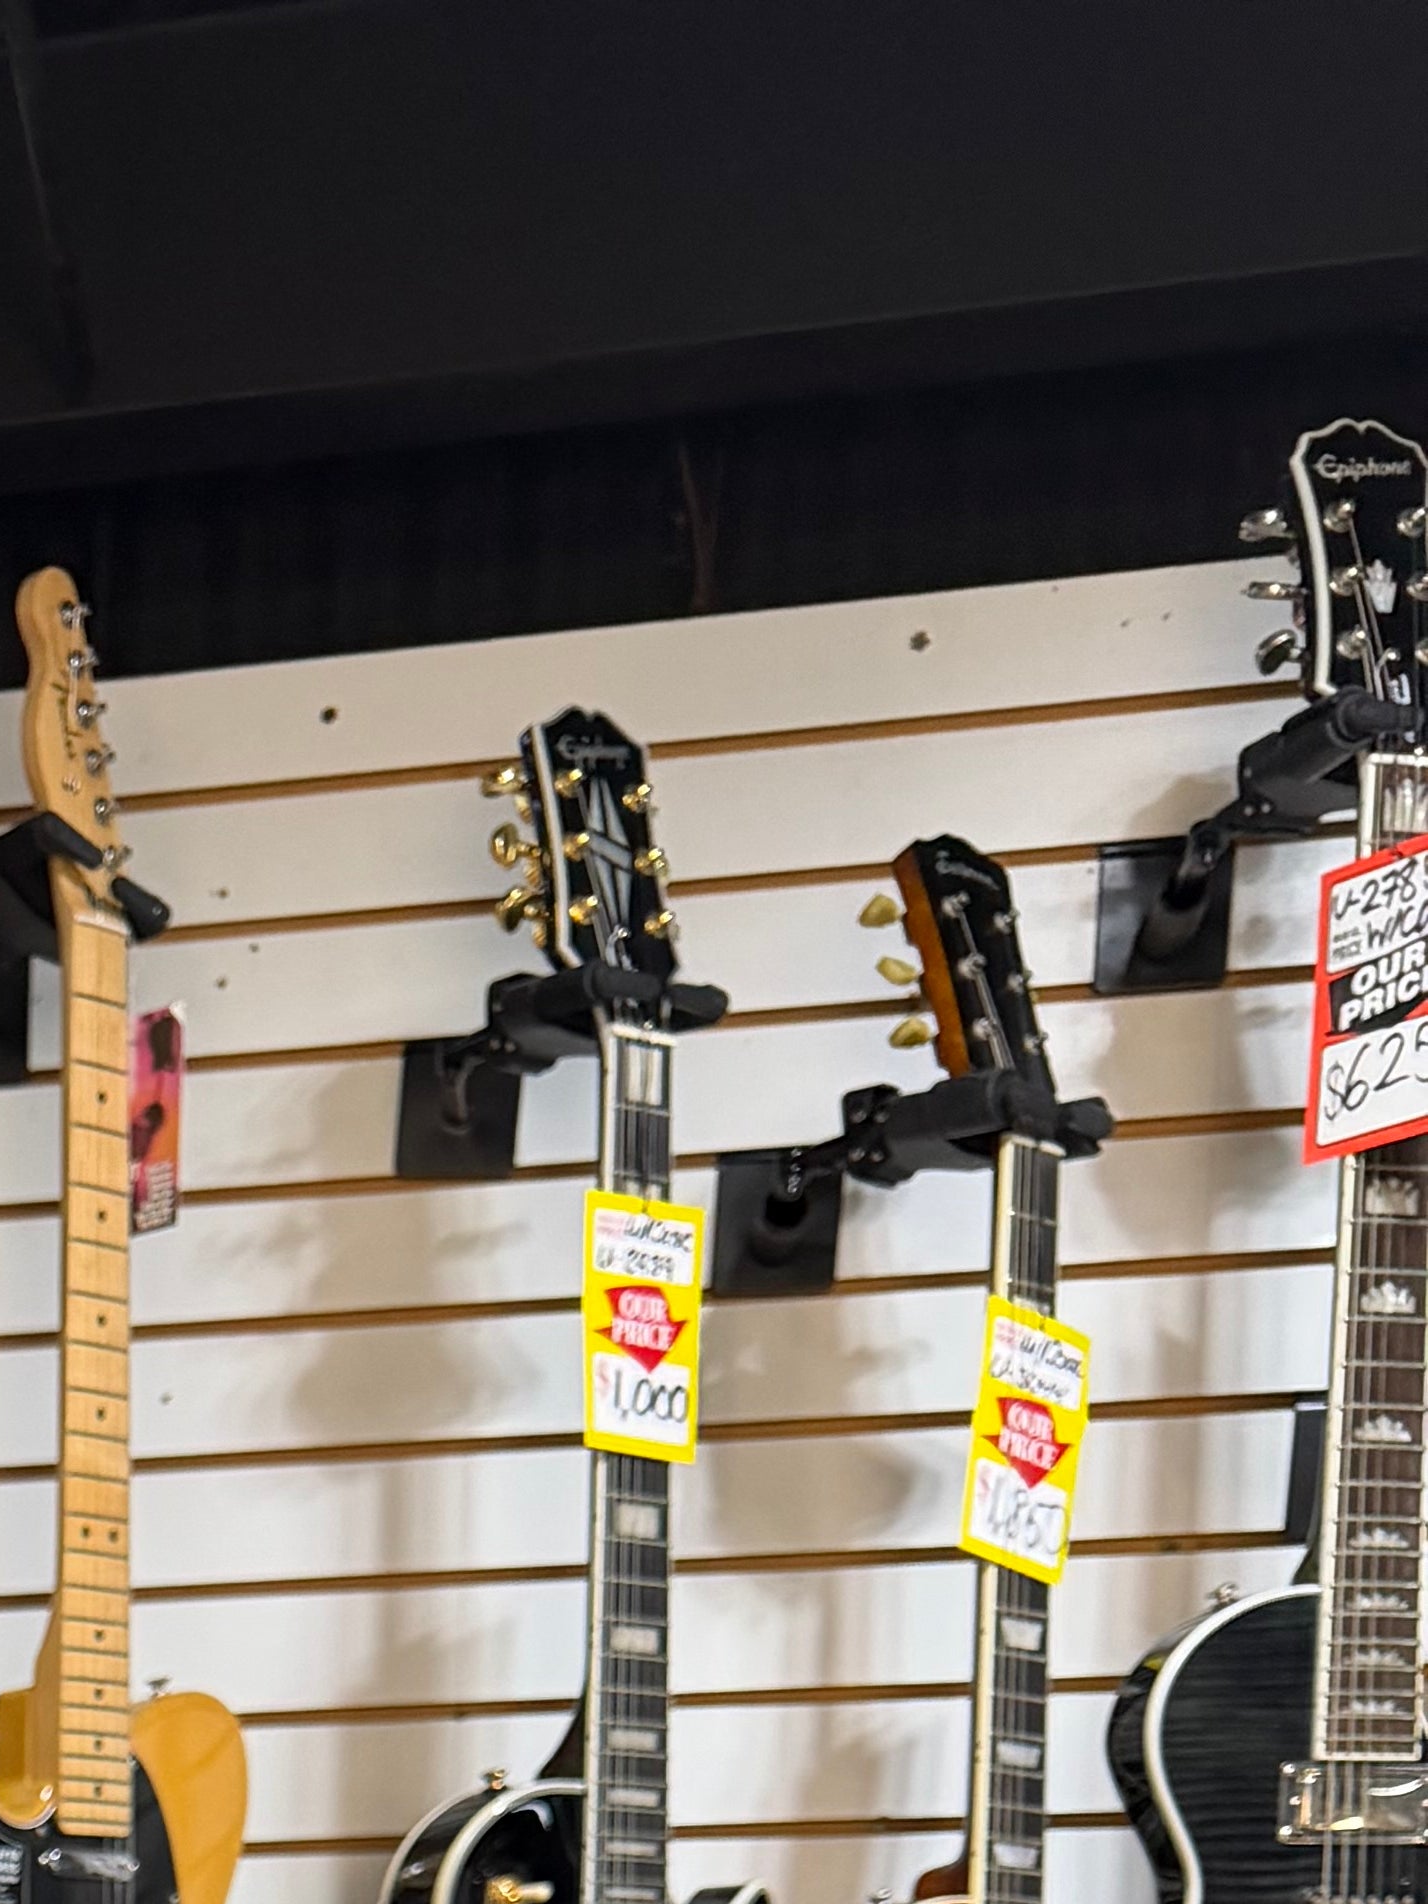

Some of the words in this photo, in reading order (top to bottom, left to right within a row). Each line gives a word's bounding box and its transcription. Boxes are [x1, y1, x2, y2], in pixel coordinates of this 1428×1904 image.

[1312, 453, 1413, 483] Epiphone
[1350, 938, 1428, 998] OUR
[1338, 968, 1428, 1034] PRIC
[616, 1288, 669, 1325] OUR
[610, 1317, 676, 1353] PRICE
[1007, 1401, 1055, 1442] OUR
[997, 1426, 1060, 1471] PRICE
